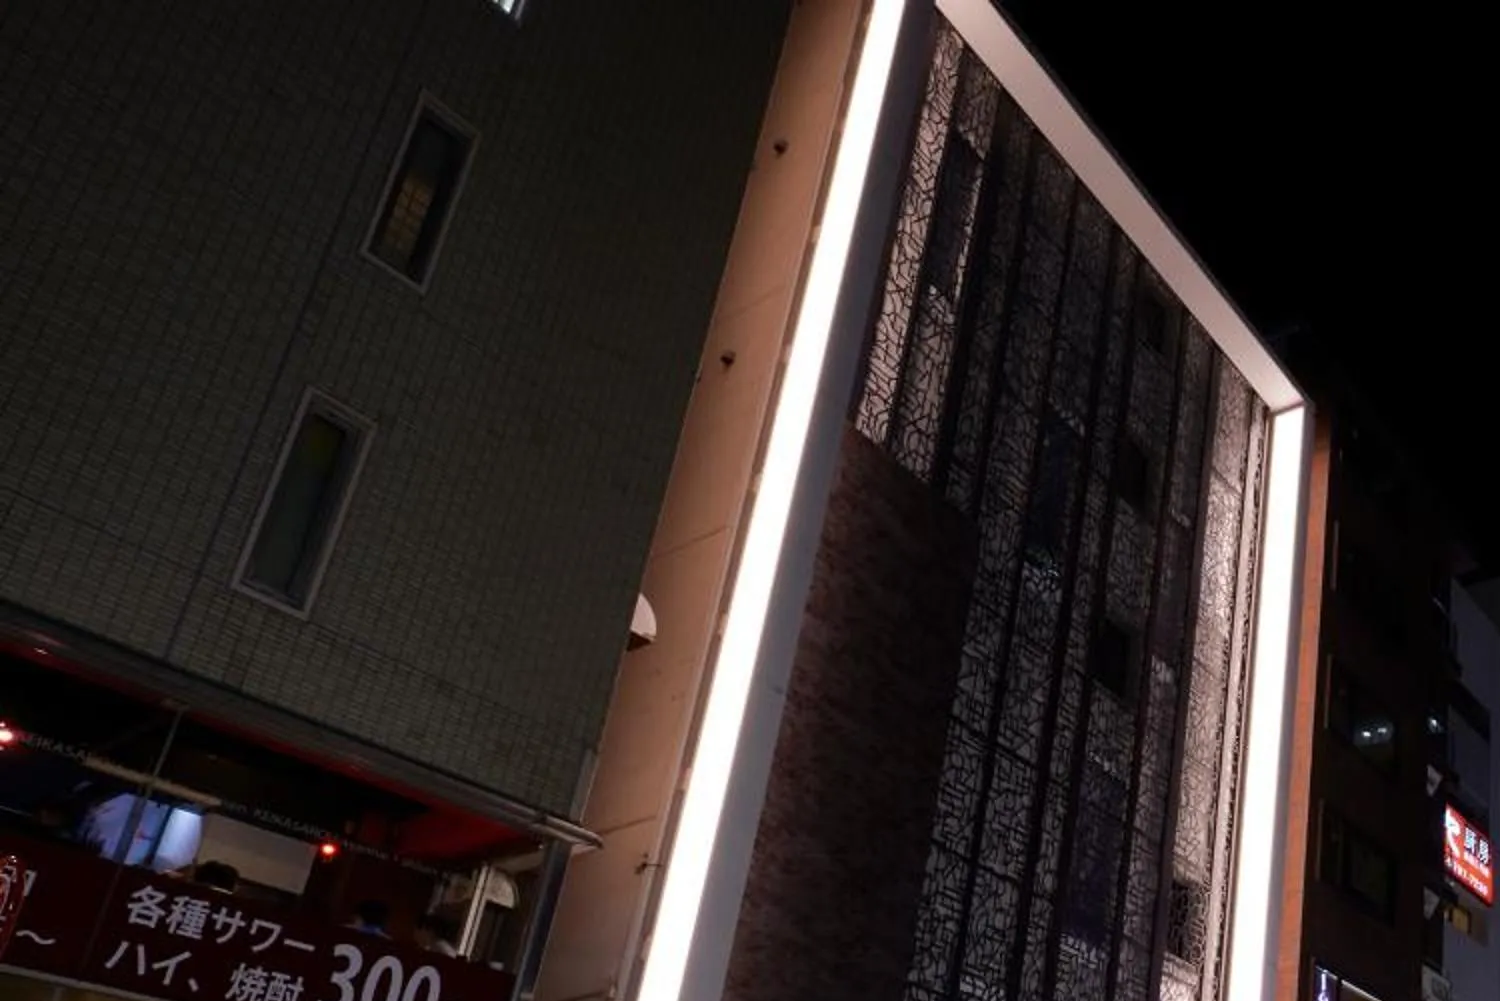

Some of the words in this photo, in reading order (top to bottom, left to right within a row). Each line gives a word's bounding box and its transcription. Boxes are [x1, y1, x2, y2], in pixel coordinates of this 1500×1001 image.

[126, 884, 316, 956] 各種サワー
